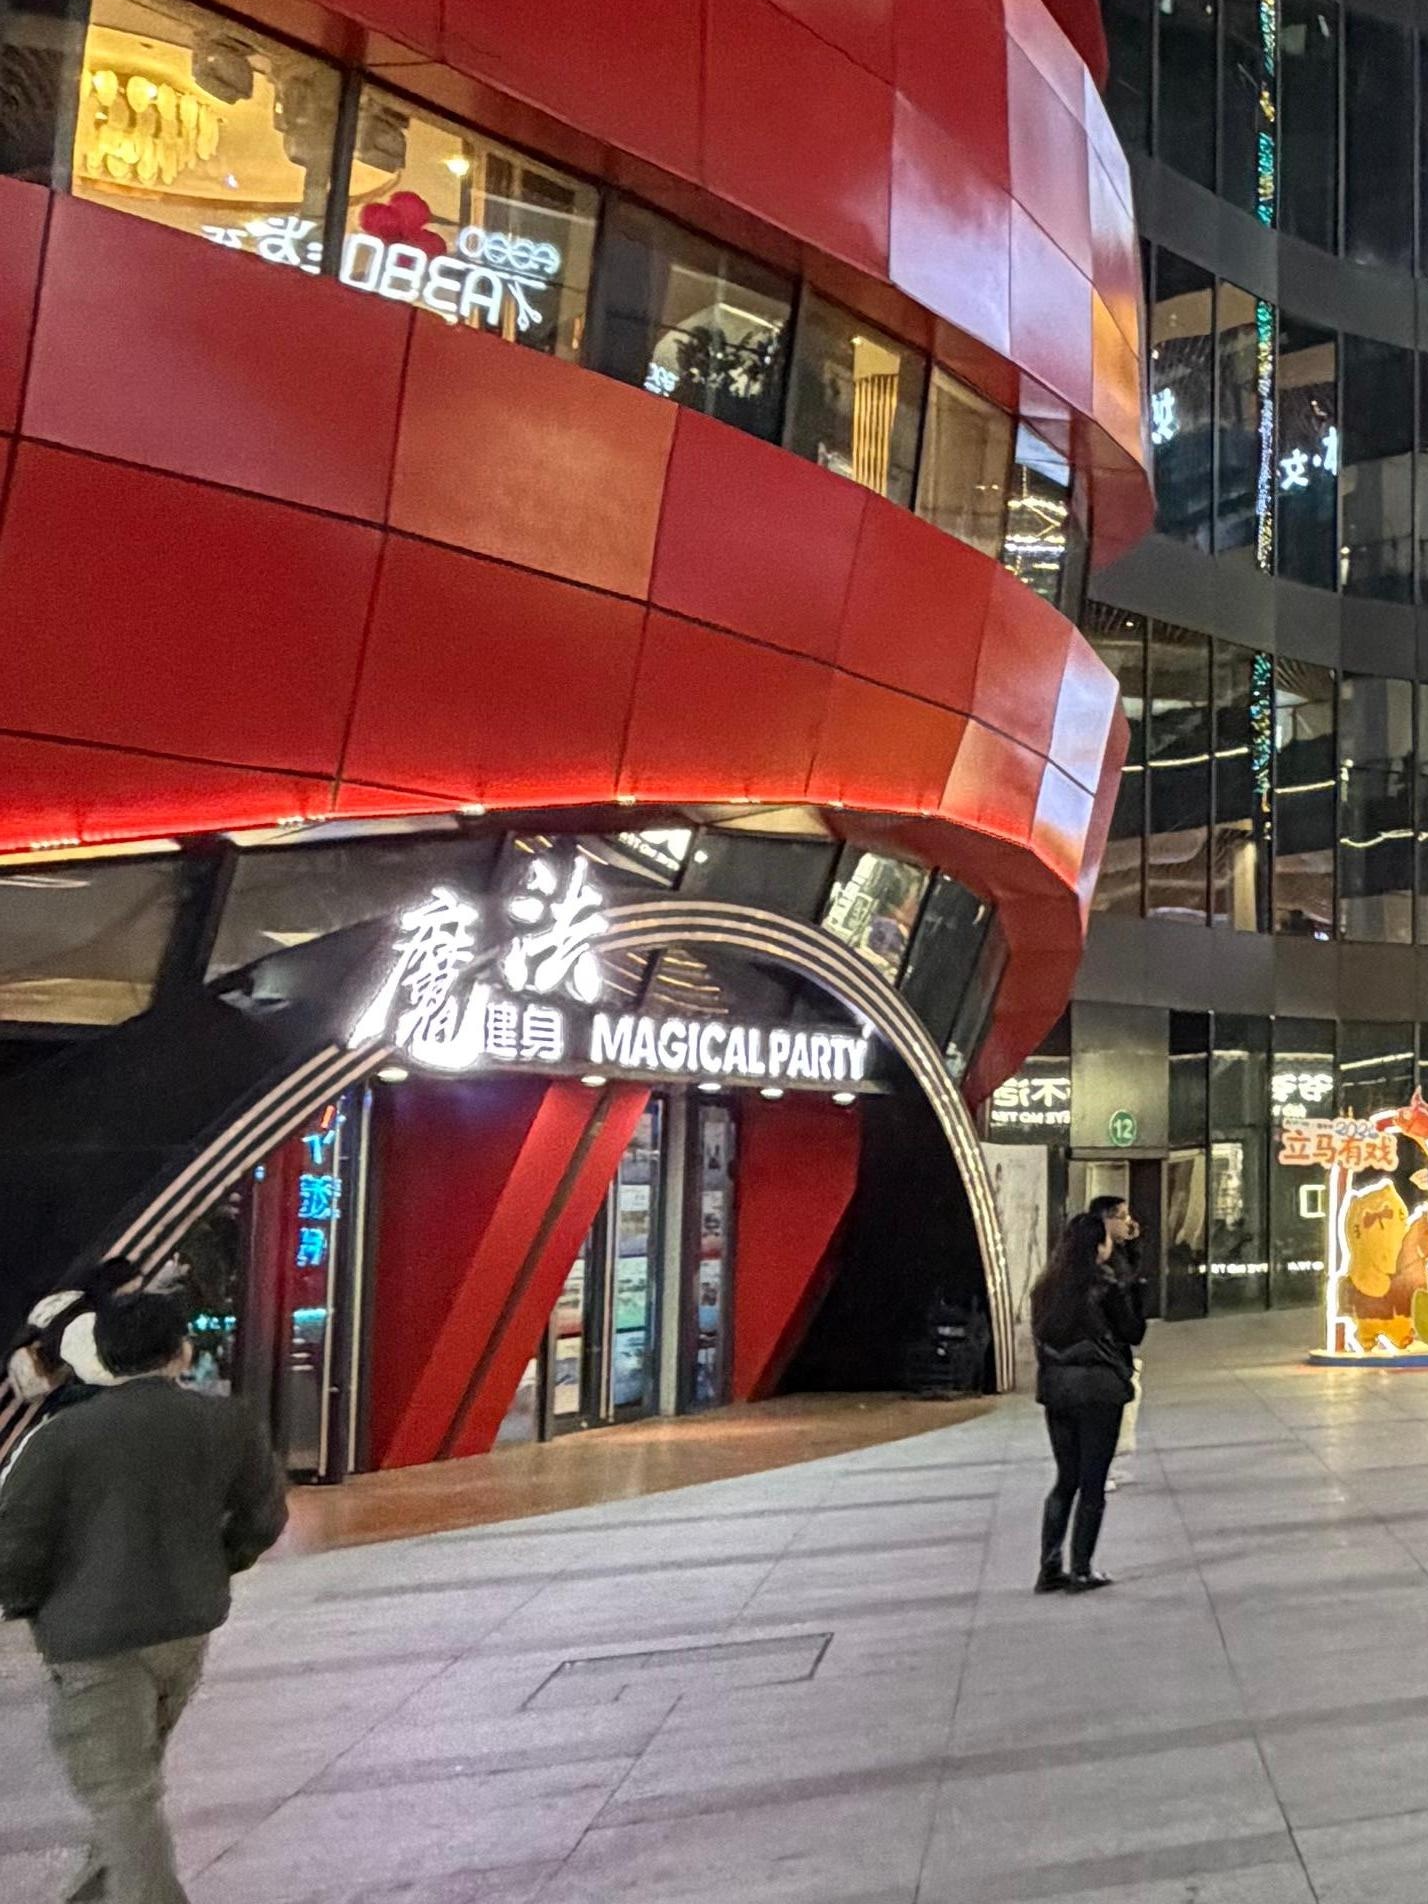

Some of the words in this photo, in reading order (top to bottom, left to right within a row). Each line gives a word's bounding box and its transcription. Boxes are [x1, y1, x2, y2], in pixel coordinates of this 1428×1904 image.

[350, 857, 608, 1071] 魔法
[485, 1004, 565, 1059] 健身
[591, 1013, 765, 1076] MAGICAL
[769, 1028, 872, 1082] PARTY
[1113, 1116, 1133, 1138] 12
[1284, 1128, 1394, 1166] 立马有戏
